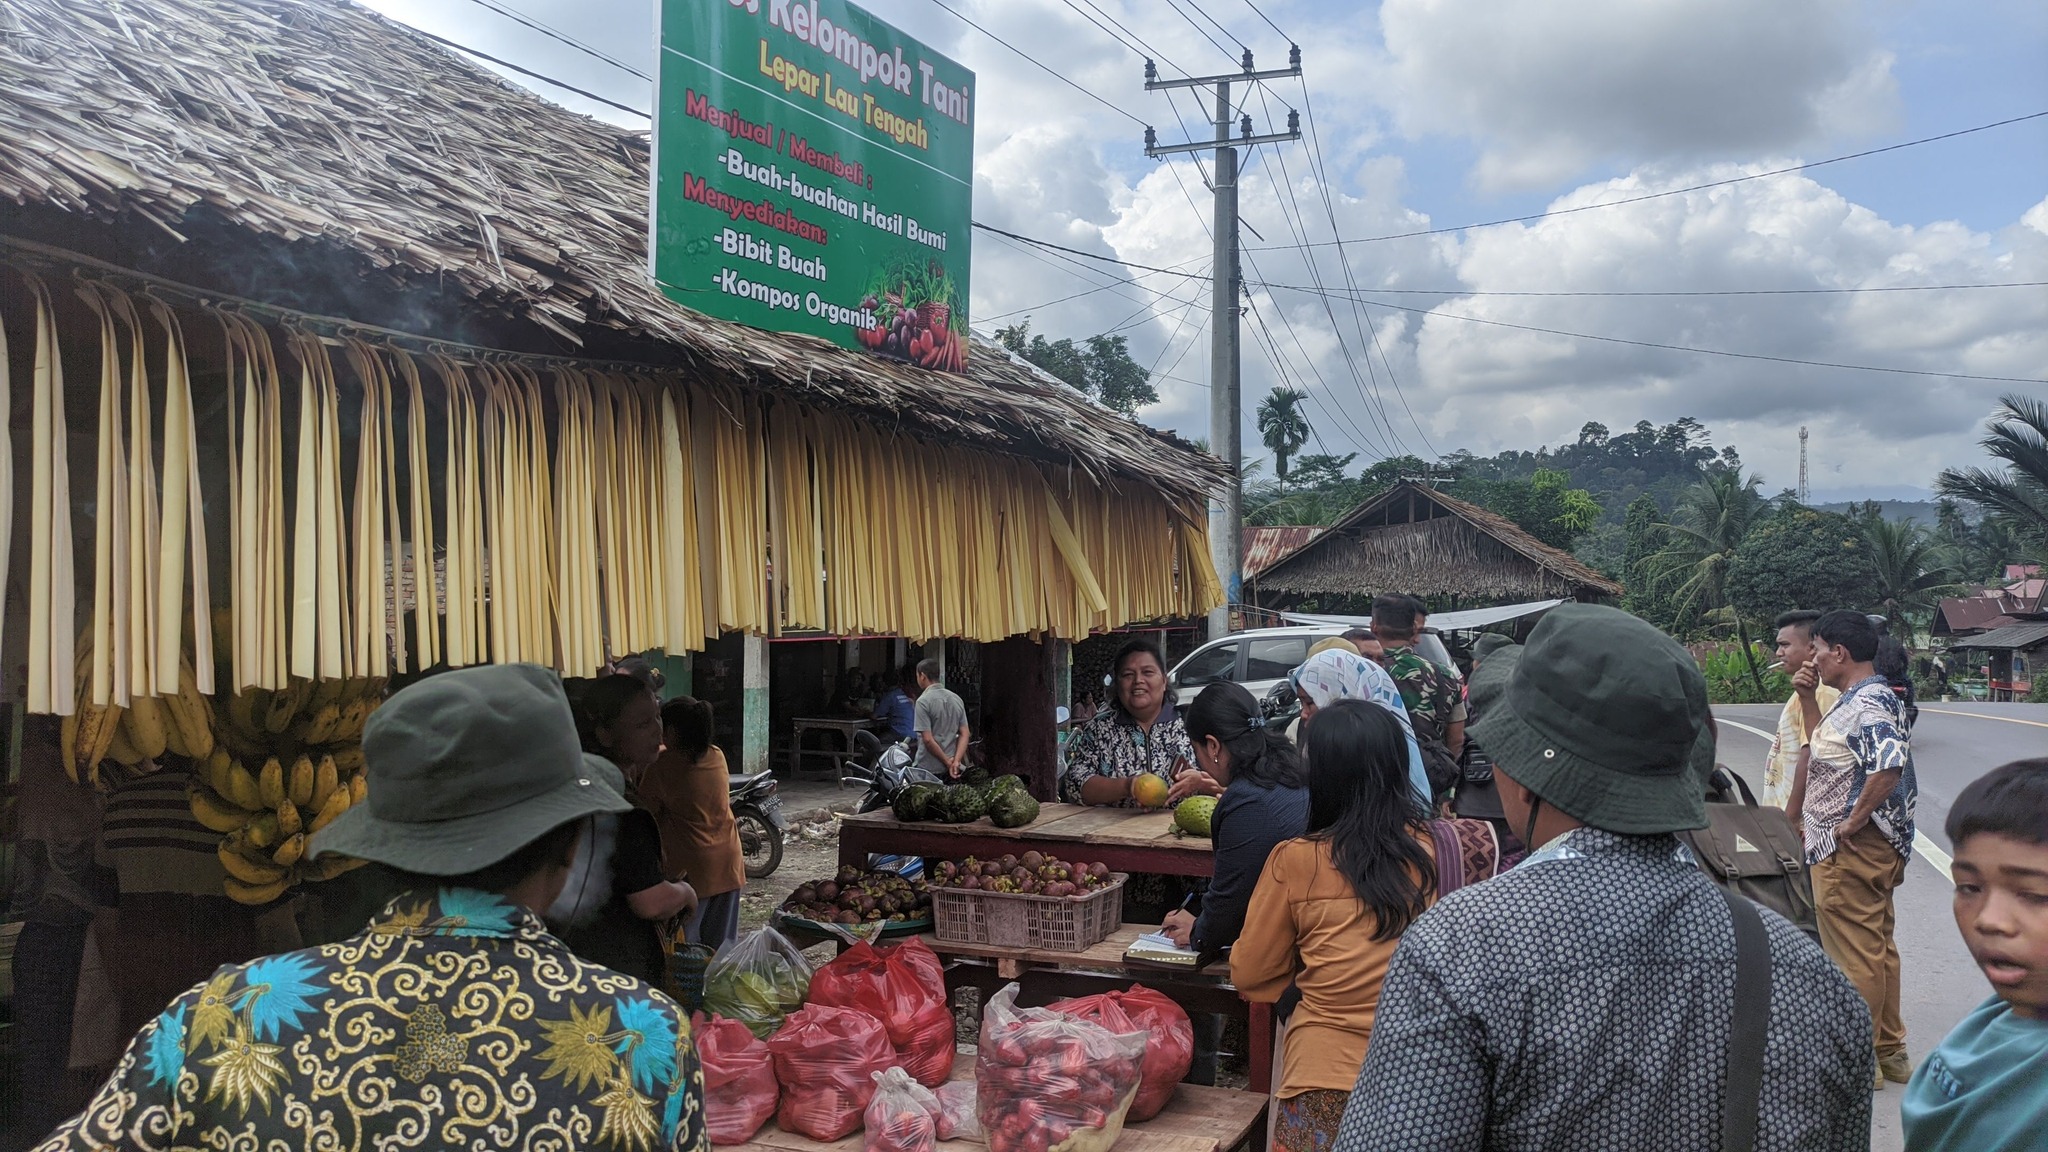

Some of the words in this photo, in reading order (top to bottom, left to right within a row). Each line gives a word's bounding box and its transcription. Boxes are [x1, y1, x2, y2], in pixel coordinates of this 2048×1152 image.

[759, 39, 819, 97] Lepar
[824, 72, 858, 118] Lau
[863, 93, 928, 149] Tengah
[769, 0, 911, 95] Kelompok
[919, 60, 968, 124] Tani
[686, 88, 773, 148] Menjual
[777, 129, 785, 153] /
[790, 133, 863, 186] Membeli
[867, 173, 872, 189] :
[684, 172, 827, 245] Menyediakan:
[718, 149, 858, 219] -Buah-buahan
[863, 202, 902, 236] Hasil
[907, 218, 947, 250] Bumi
[713, 268, 800, 311] -Kompos
[805, 293, 877, 331] Organik
[714, 228, 773, 265] -Bibit
[778, 245, 827, 281] Buah
